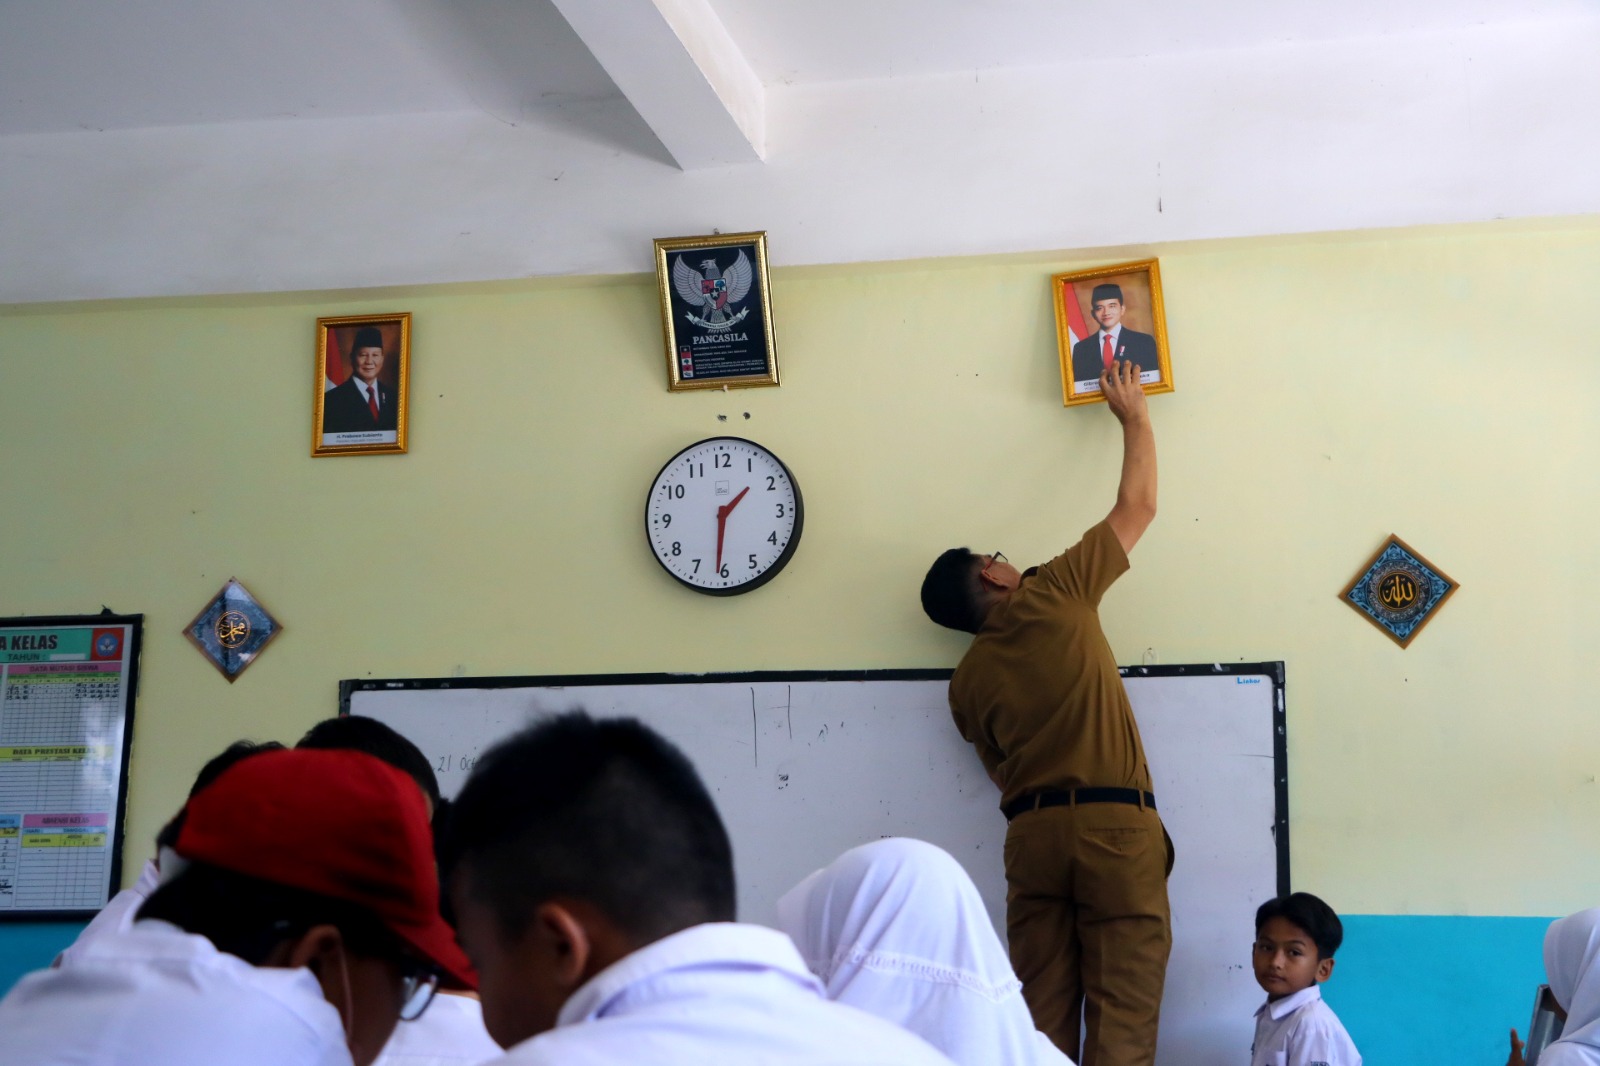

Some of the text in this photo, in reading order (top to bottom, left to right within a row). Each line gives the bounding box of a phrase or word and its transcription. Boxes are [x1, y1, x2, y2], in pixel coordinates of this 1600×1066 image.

[693, 332, 748, 344] PANCASILA
[715, 453, 732, 468] 12
[747, 458, 751, 472] 1
[690, 463, 703, 478] 11
[766, 476, 776, 491] 2
[668, 484, 685, 500] 10
[775, 504, 785, 518] 3
[662, 514, 672, 528] 9
[767, 531, 777, 545] 4
[672, 541, 682, 556] 8
[691, 558, 701, 573] 7
[748, 554, 757, 569] 5
[720, 563, 730, 578] 6
[11, 635, 58, 651] KELAS
[438, 754, 452, 772] 21
